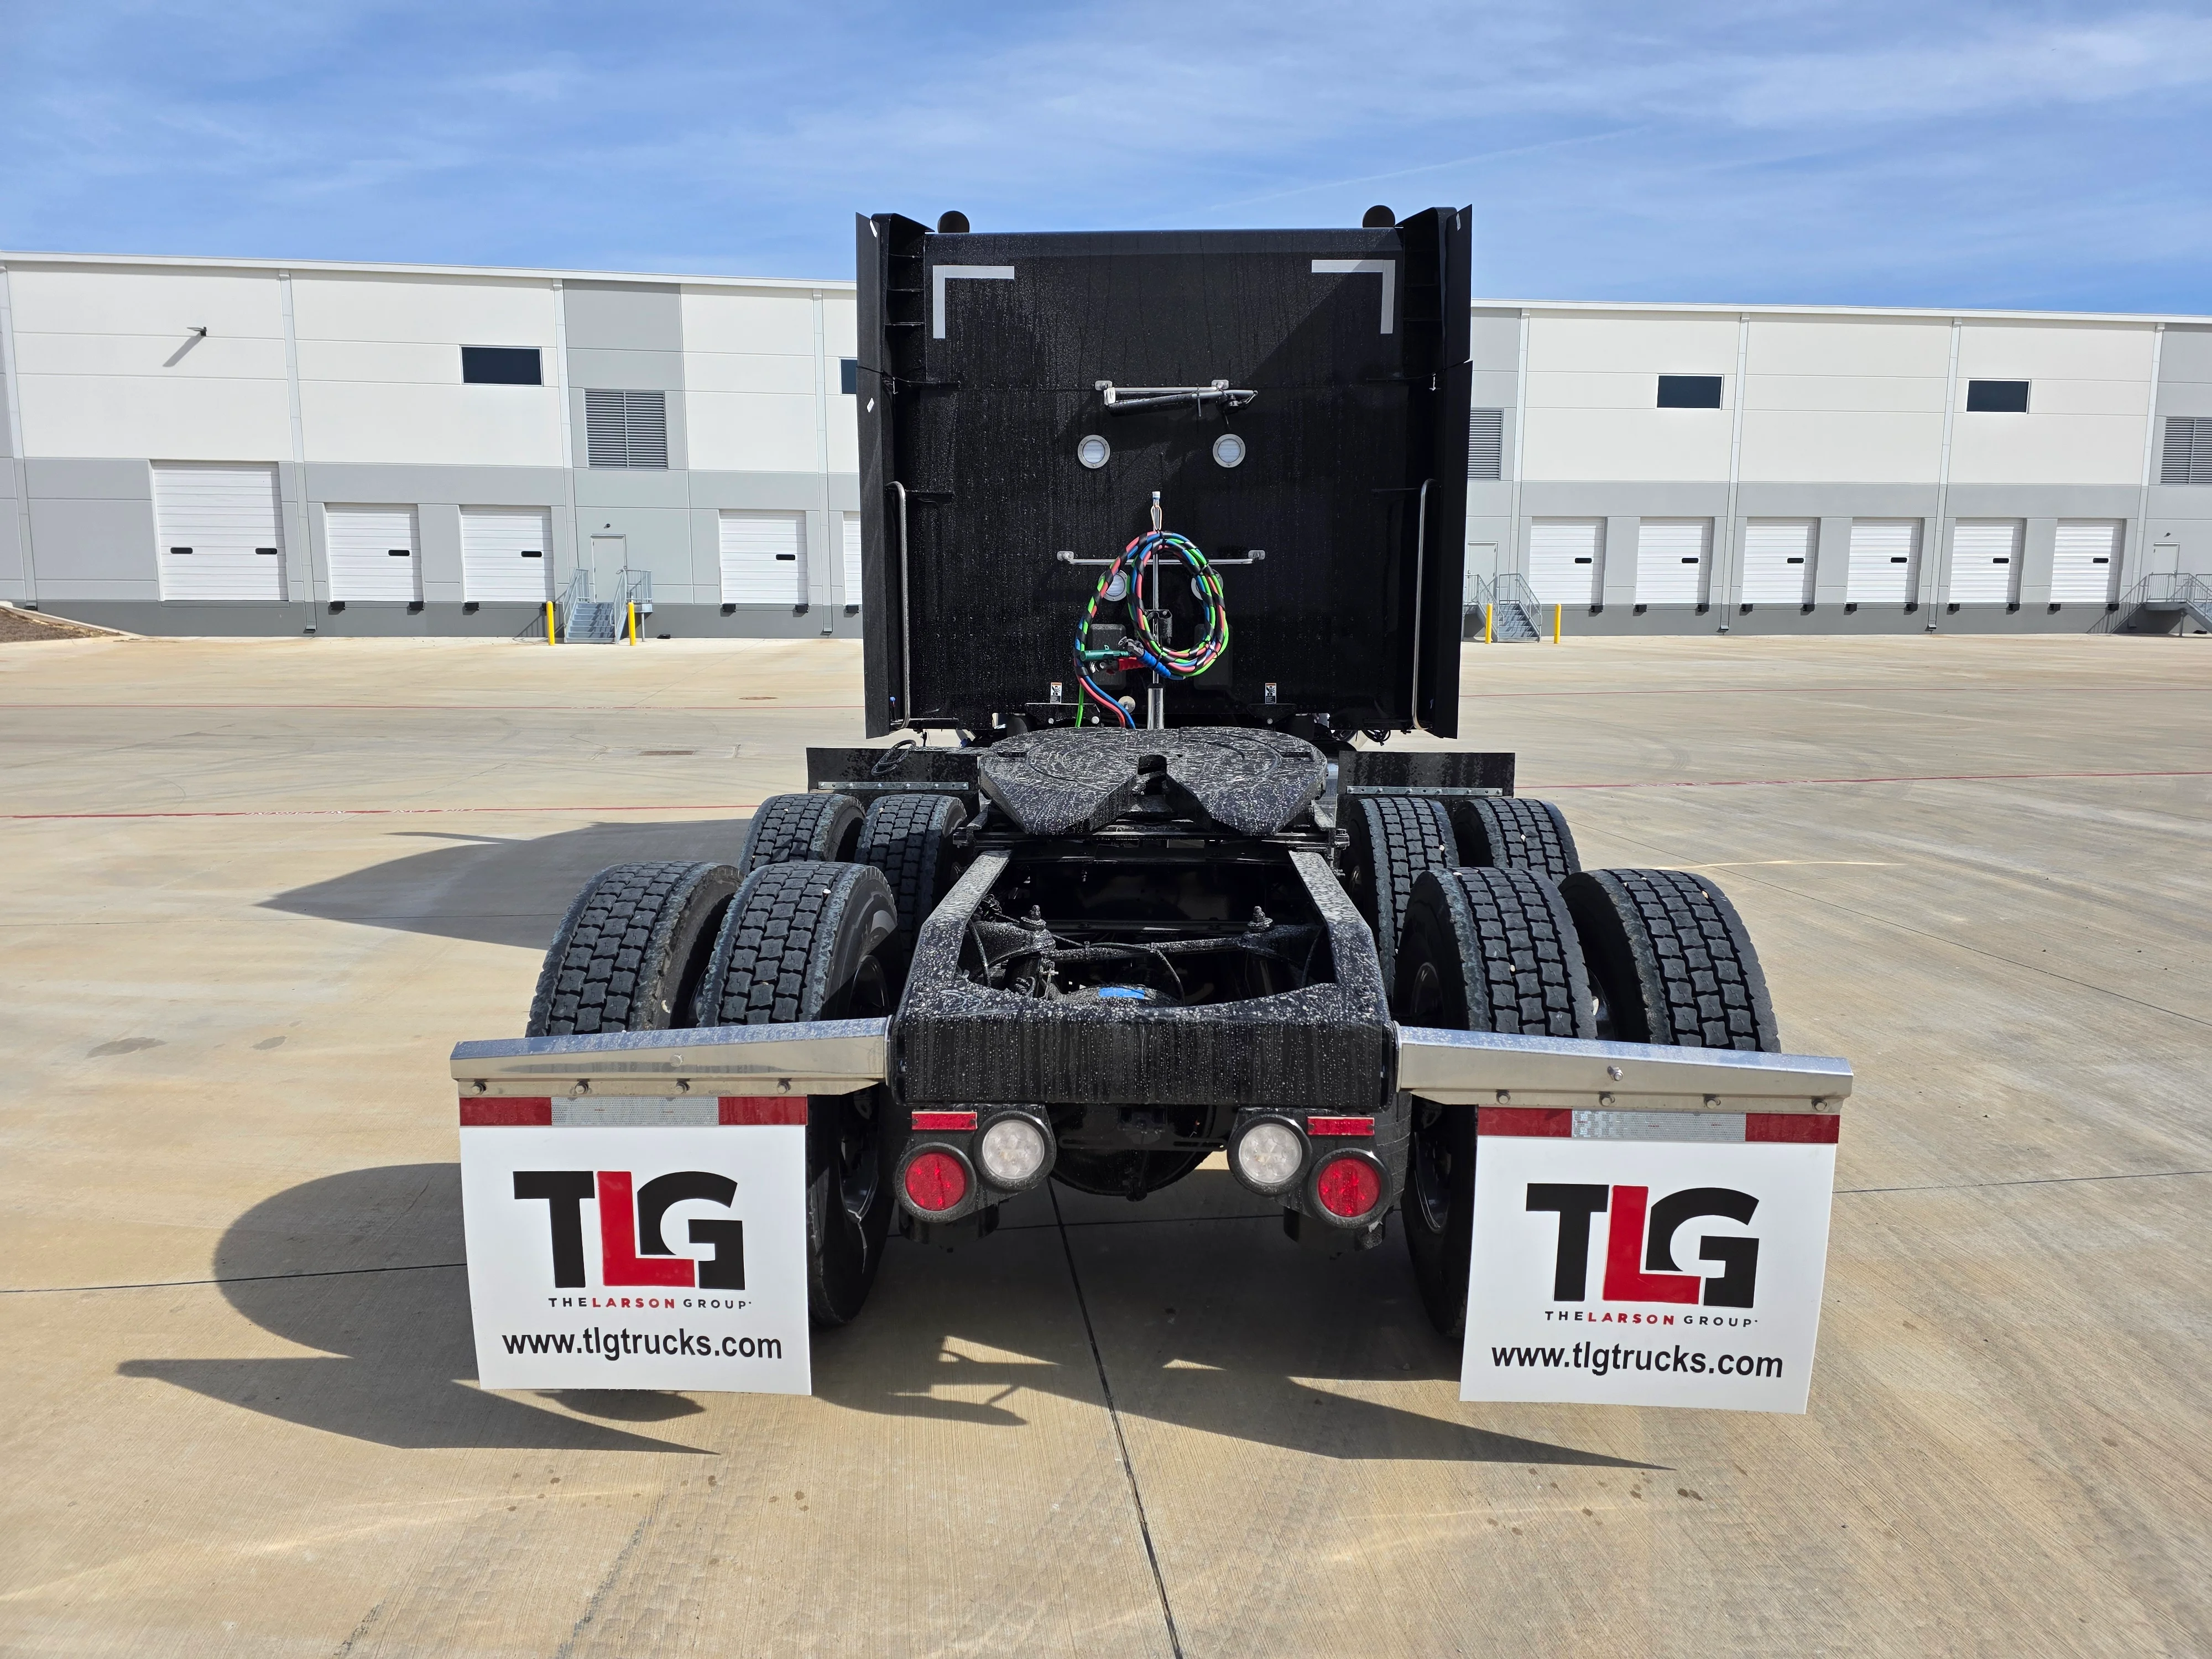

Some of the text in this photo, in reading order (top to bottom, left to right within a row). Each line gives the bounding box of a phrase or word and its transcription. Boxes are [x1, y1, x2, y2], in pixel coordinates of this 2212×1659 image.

[513, 1171, 745, 1290] TLG
[1526, 1183, 1760, 1309] TLG
[683, 1298, 747, 1310] GROUP
[1683, 1315, 1752, 1327] GROUP
[502, 1327, 782, 1361] www.tlgtrucks.com
[1491, 1341, 1783, 1378] www.tlgtrucks.com
